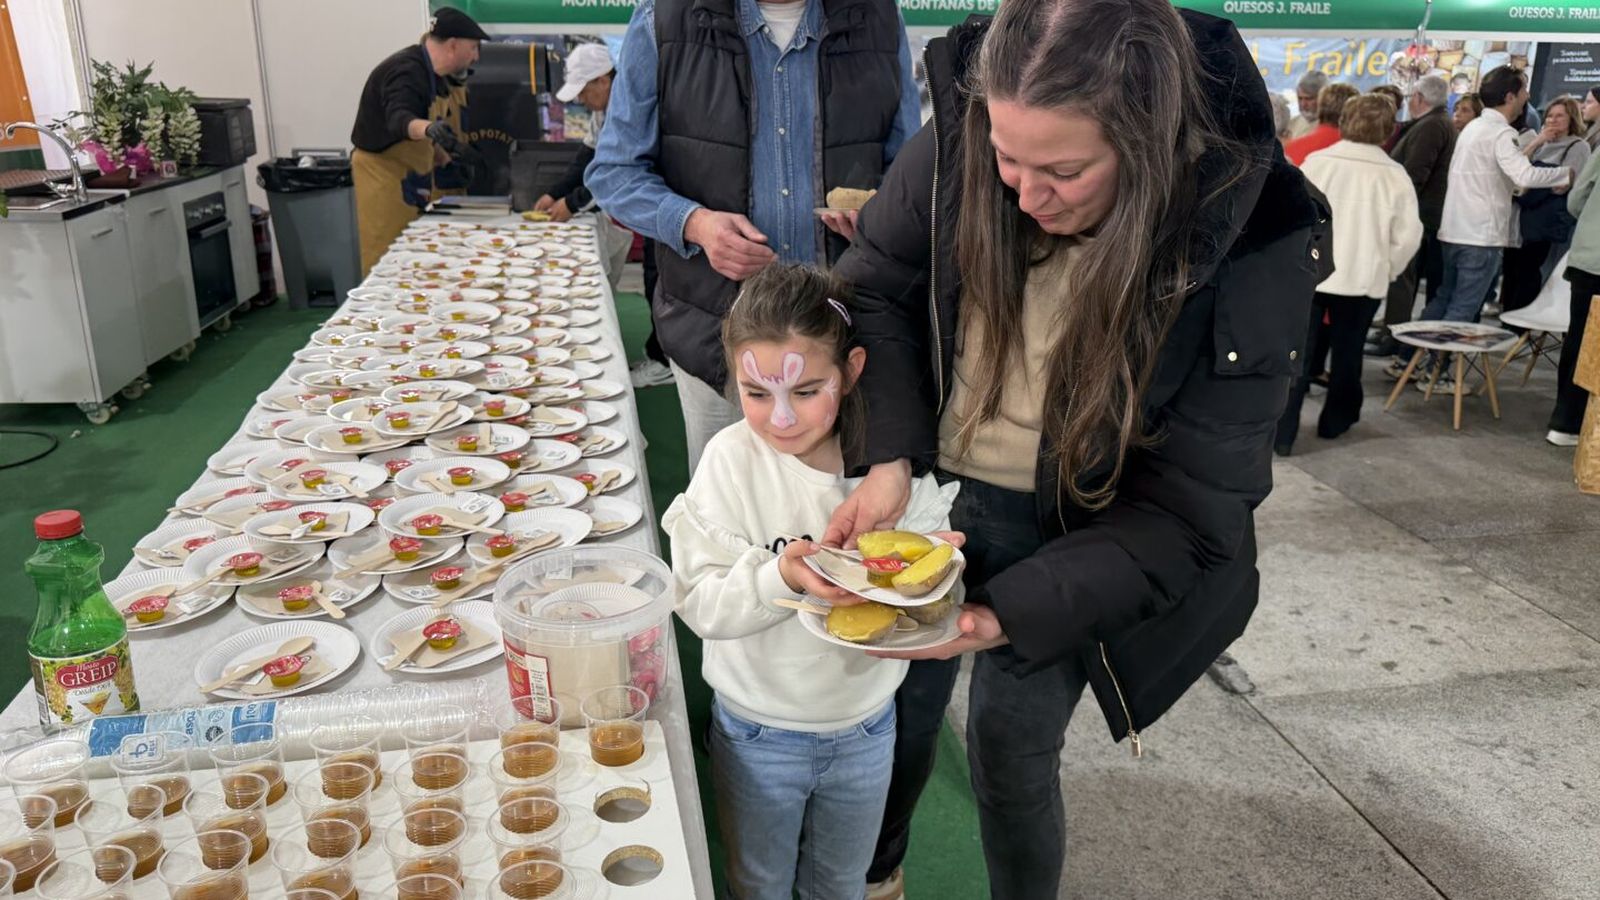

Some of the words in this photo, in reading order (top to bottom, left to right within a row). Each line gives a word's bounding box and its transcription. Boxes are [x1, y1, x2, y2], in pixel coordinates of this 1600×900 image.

[977, 0, 995, 11] DE
[1223, 1, 1275, 14] QUESOS
[1276, 2, 1287, 14] J.
[1290, 2, 1331, 14] FRAILE
[1509, 6, 1555, 19] QUESOS
[1556, 7, 1566, 19] J.
[1568, 7, 1600, 19] FRAIL
[1284, 40, 1387, 76] Fraile
[60, 661, 117, 687] GREIP
